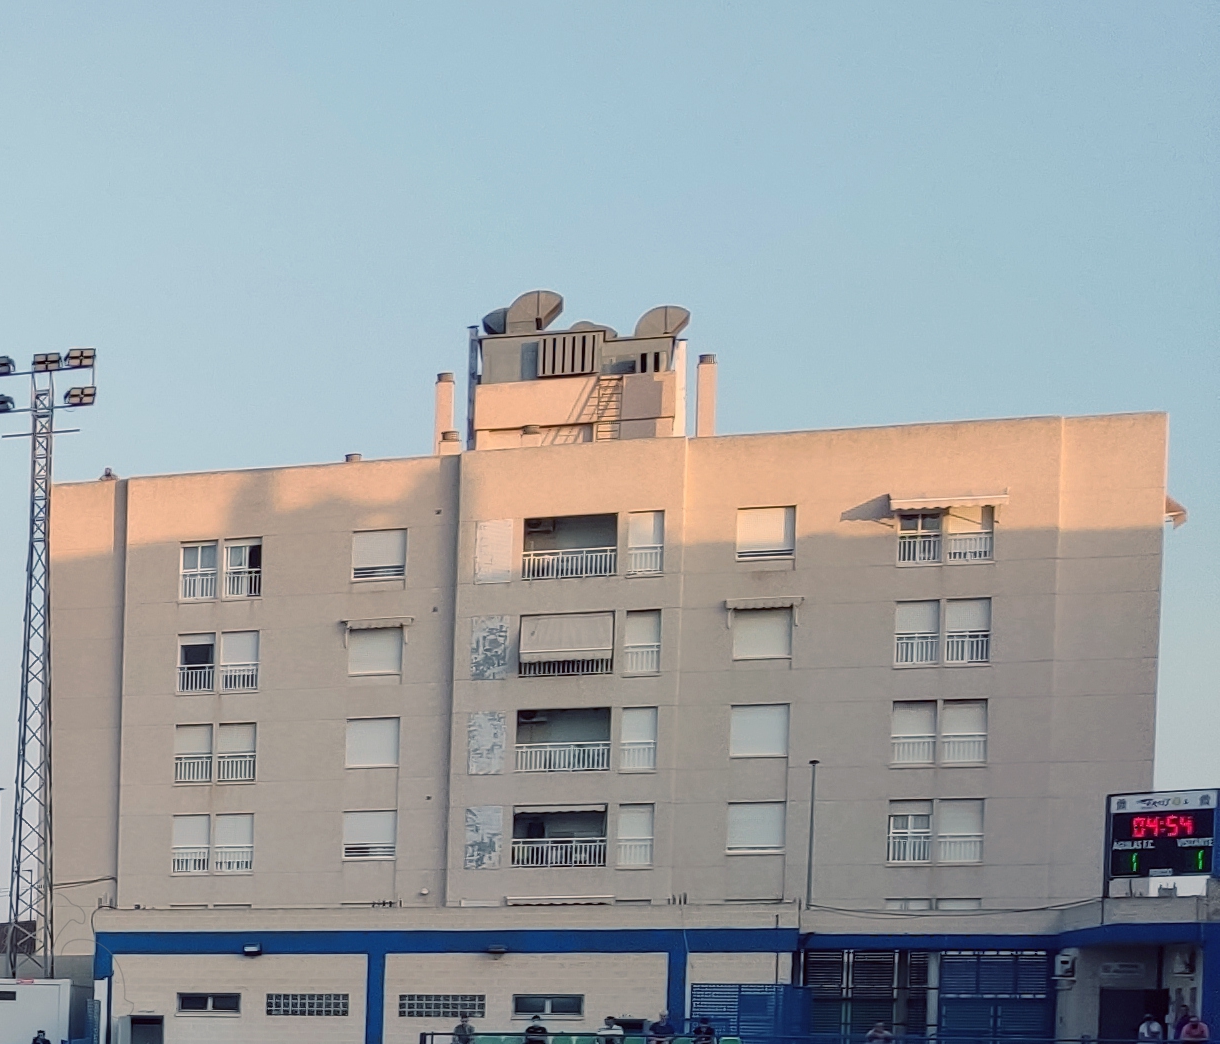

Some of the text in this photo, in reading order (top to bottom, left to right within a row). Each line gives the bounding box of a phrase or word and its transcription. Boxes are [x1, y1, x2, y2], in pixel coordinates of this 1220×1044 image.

[1132, 815, 1194, 838] 04:54
[1132, 852, 1138, 872] 1
[1198, 850, 1204, 870] 1
